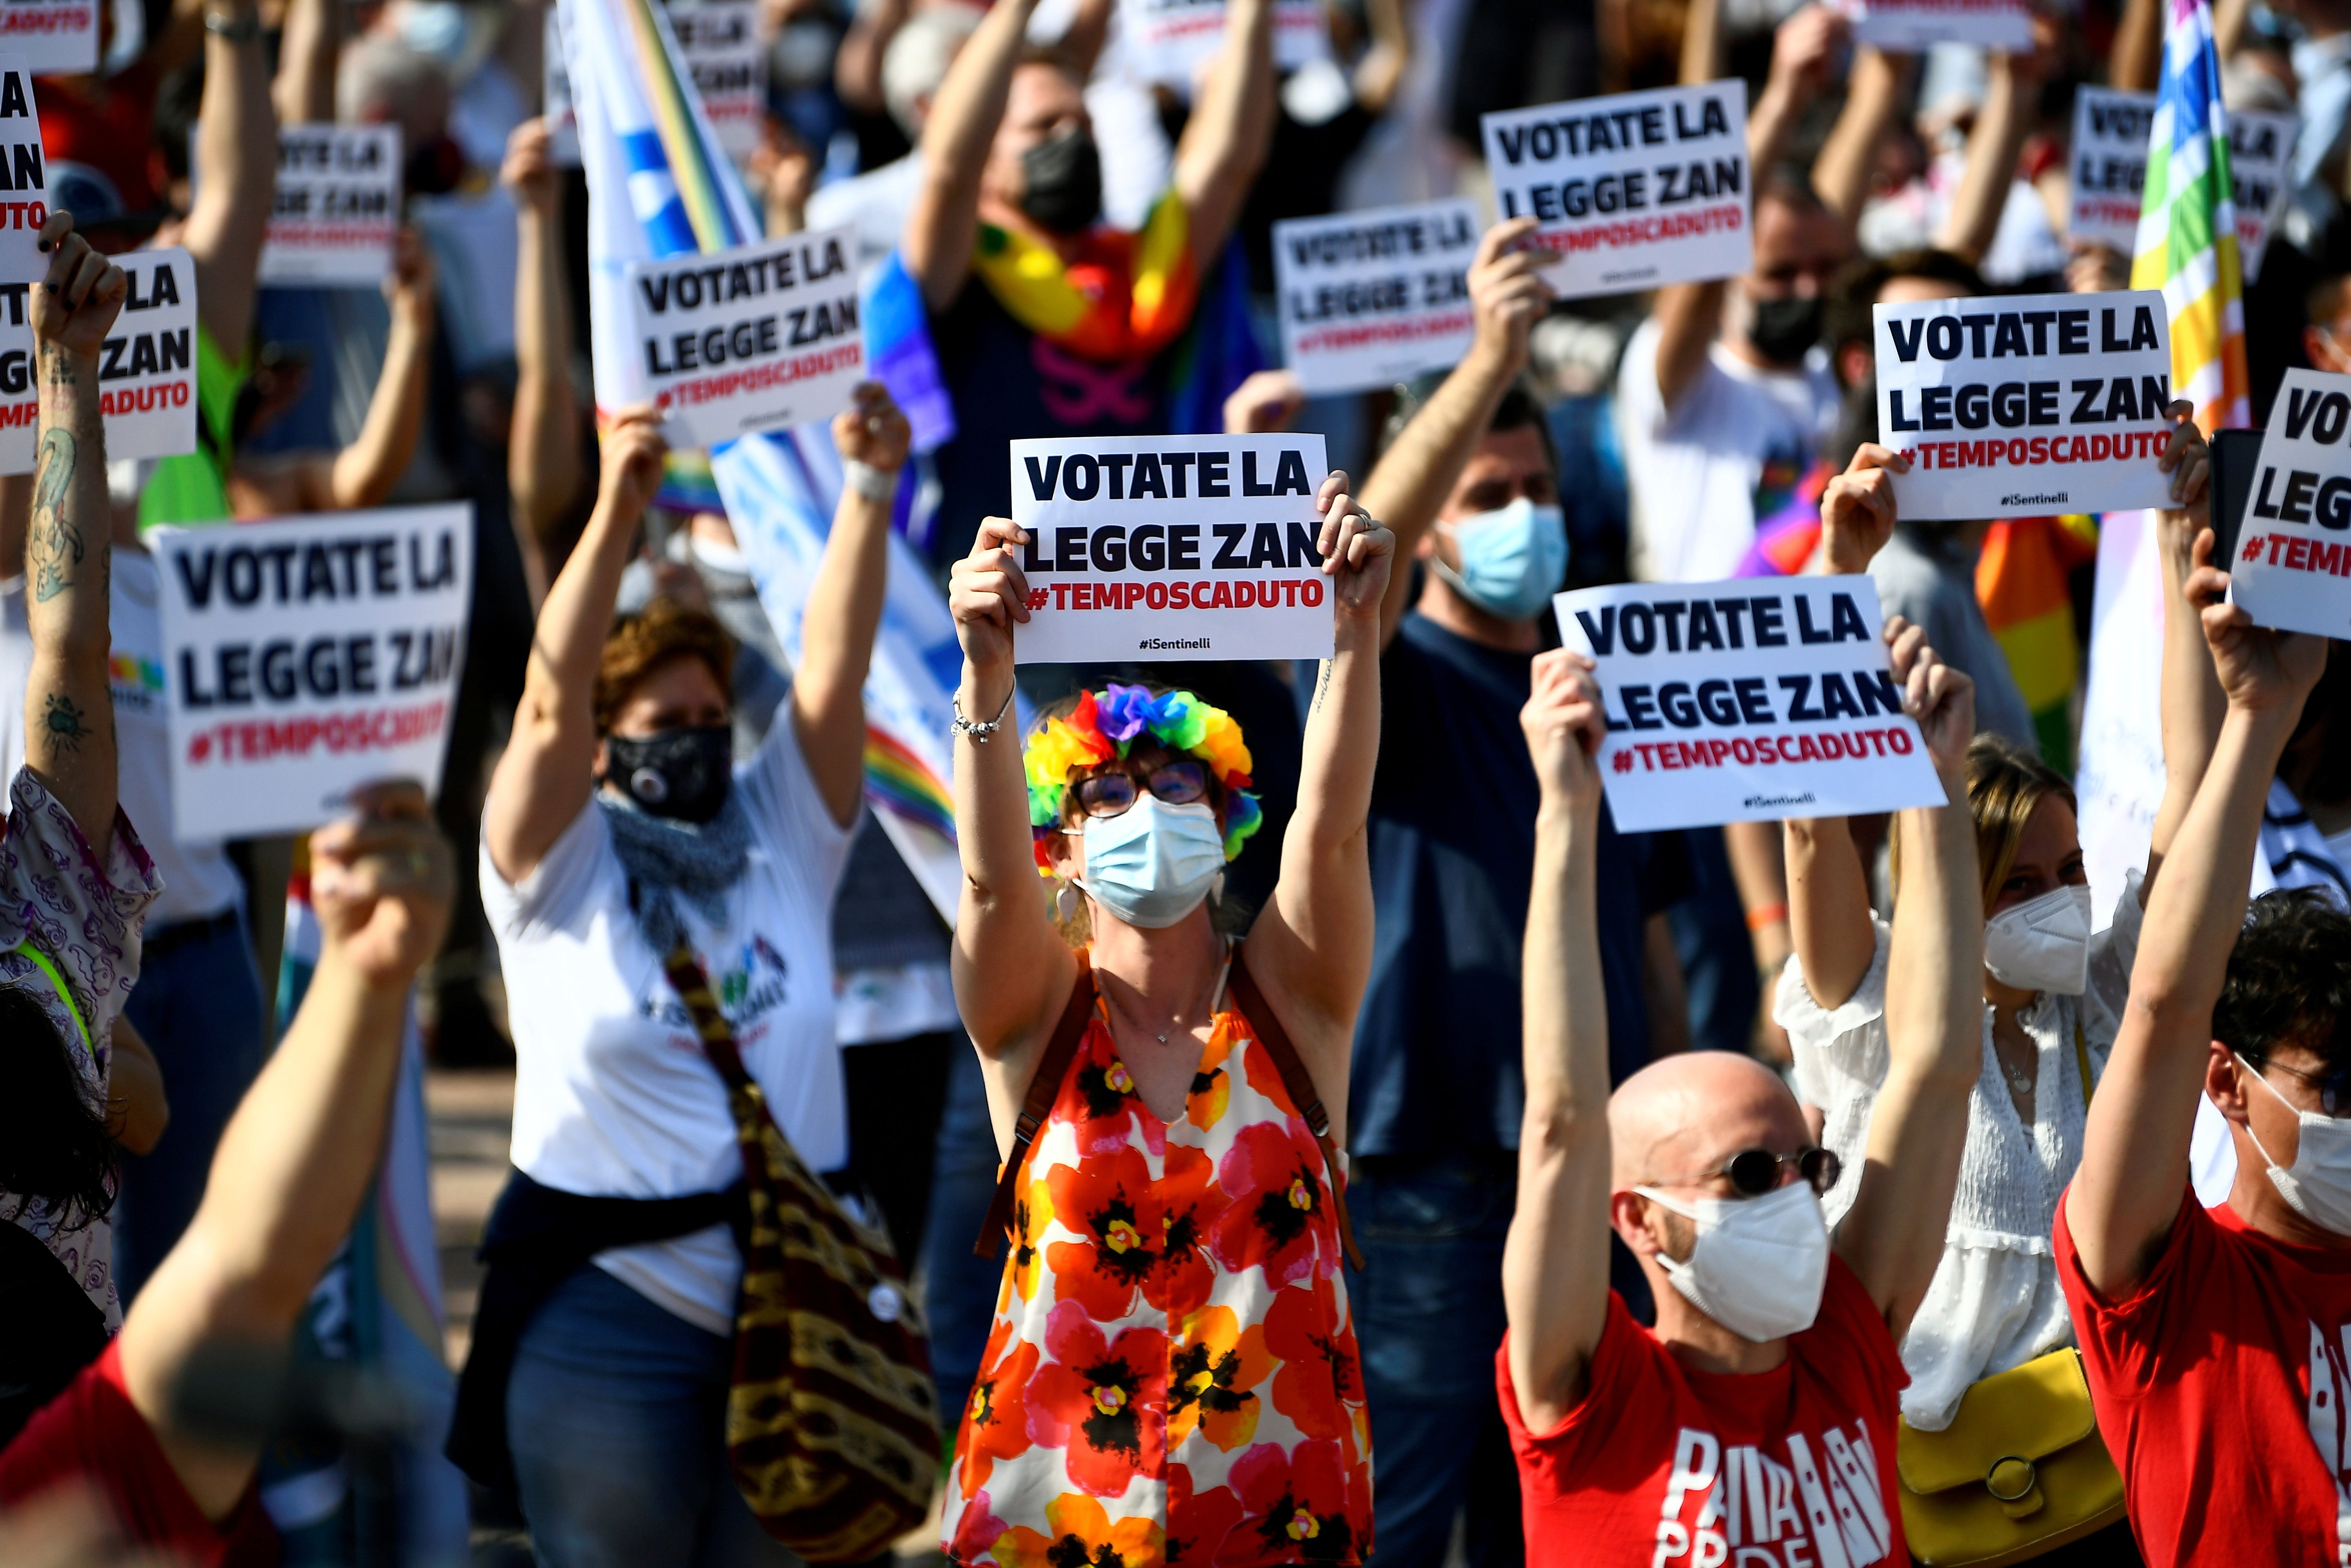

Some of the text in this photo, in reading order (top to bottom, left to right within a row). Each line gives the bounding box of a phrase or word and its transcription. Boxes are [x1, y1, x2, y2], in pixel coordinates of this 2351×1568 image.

[1497, 96, 1728, 165] VOTATE LA
[1502, 157, 1740, 220] LEGGE ZAN
[640, 236, 846, 314] VOTATE LA
[645, 293, 857, 377] LEGGE ZAN
[1888, 305, 2159, 362] VOTATE LA
[655, 344, 860, 410] #TEMPOSCADUTO
[1890, 375, 2171, 432] LEGGE ZAN
[2285, 388, 2351, 445] VO
[1024, 450, 1311, 501] VOTATE LA
[1899, 431, 2172, 470] #TEMPOSCADUTO
[2001, 492, 2069, 506] #iSentinelli
[178, 531, 456, 608] VOTATE LA
[1023, 521, 1322, 572] LEGGE ZAN
[1025, 579, 1323, 611] #TEMPOSCADUTO
[1139, 637, 1210, 651] #iSentinelli
[1575, 593, 1870, 655] VOTATE LA
[180, 633, 377, 709] LEGGE
[1603, 670, 1903, 730] LEGGE ZAN
[1613, 727, 1913, 773] #TEMPOSCADUTO
